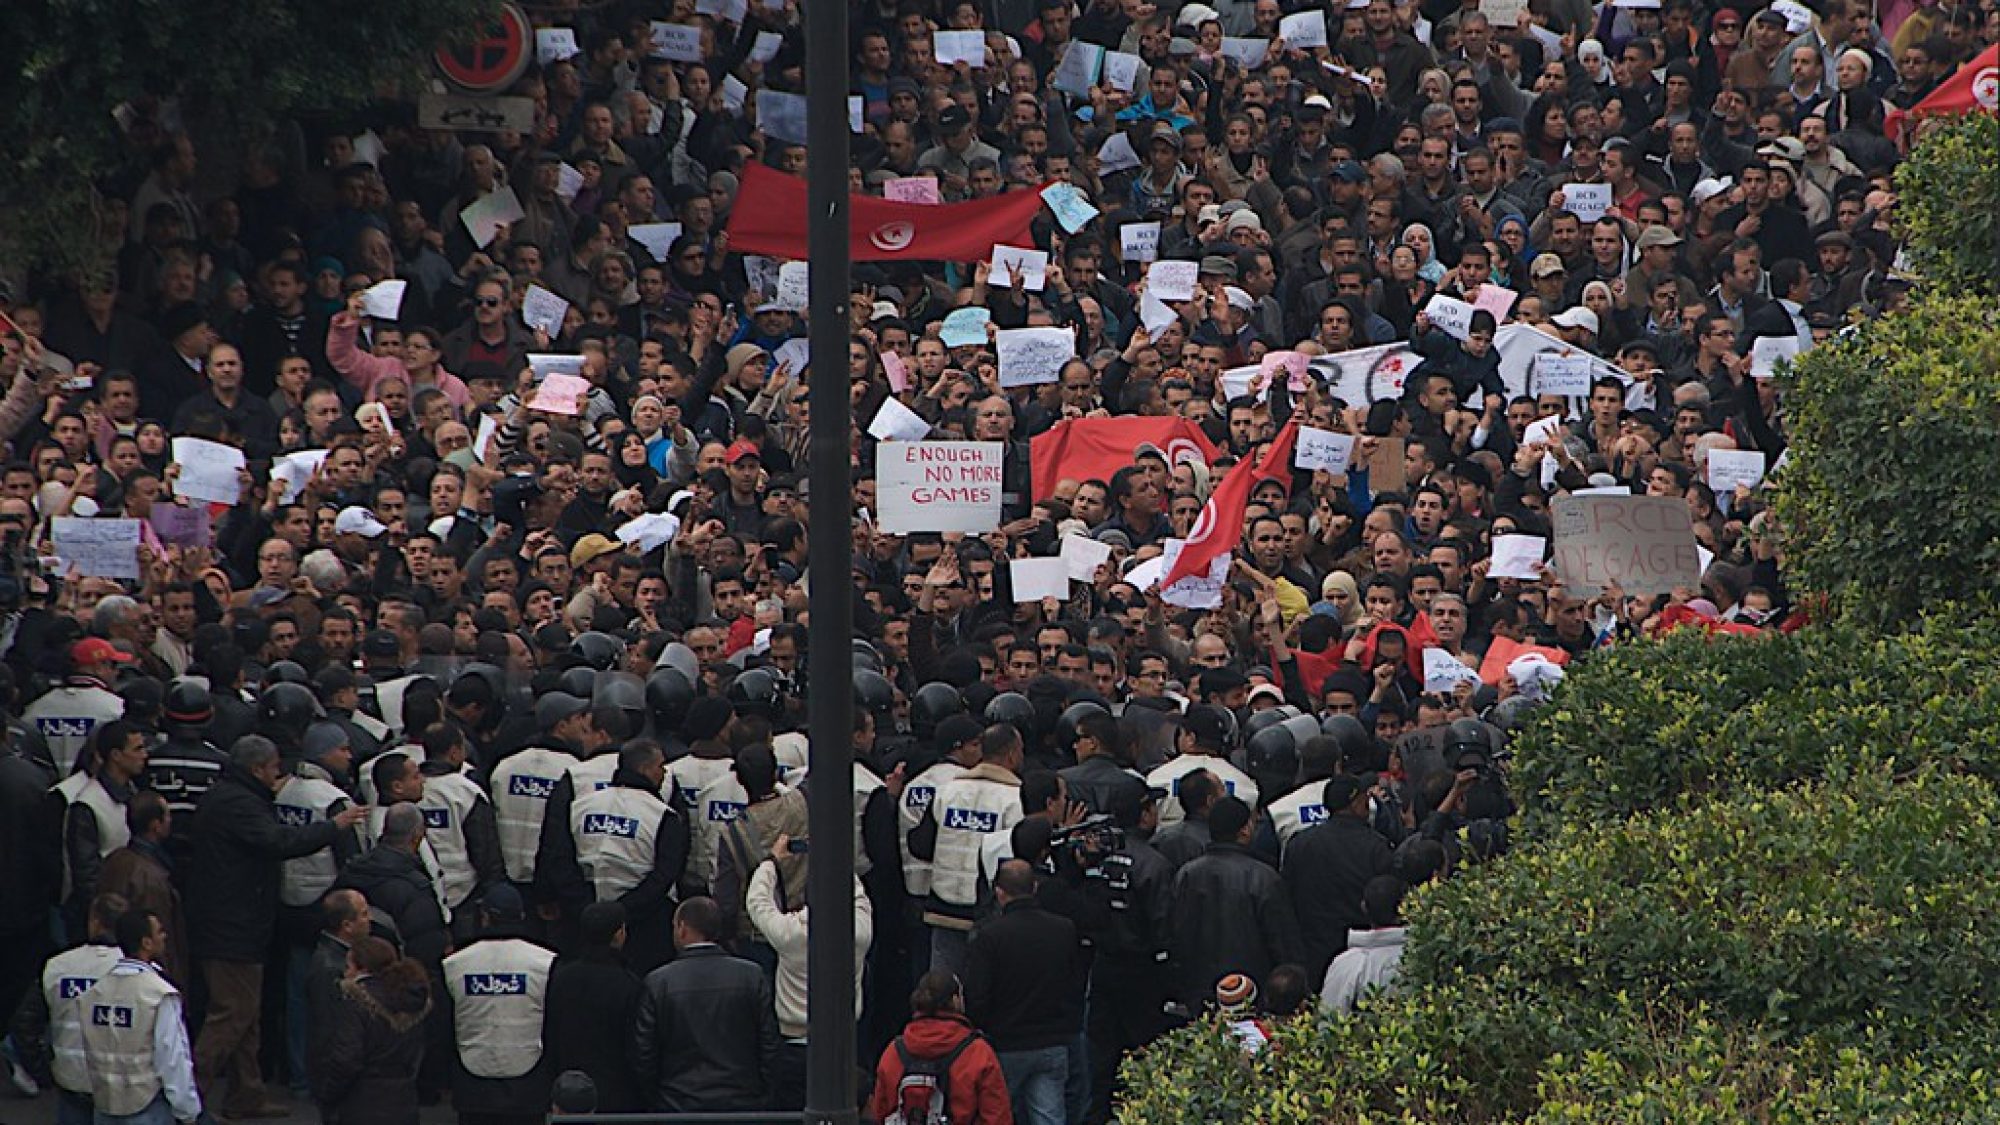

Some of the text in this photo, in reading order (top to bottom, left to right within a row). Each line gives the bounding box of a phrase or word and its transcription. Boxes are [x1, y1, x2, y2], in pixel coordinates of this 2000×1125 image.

[925, 464, 1001, 483] NO MORE
[911, 487, 991, 504] GAMES
[1592, 501, 1692, 534] RCD
[1558, 542, 1699, 585] DEGAGE
[589, 816, 630, 834] شرطة
[470, 974, 520, 994] شرطة
